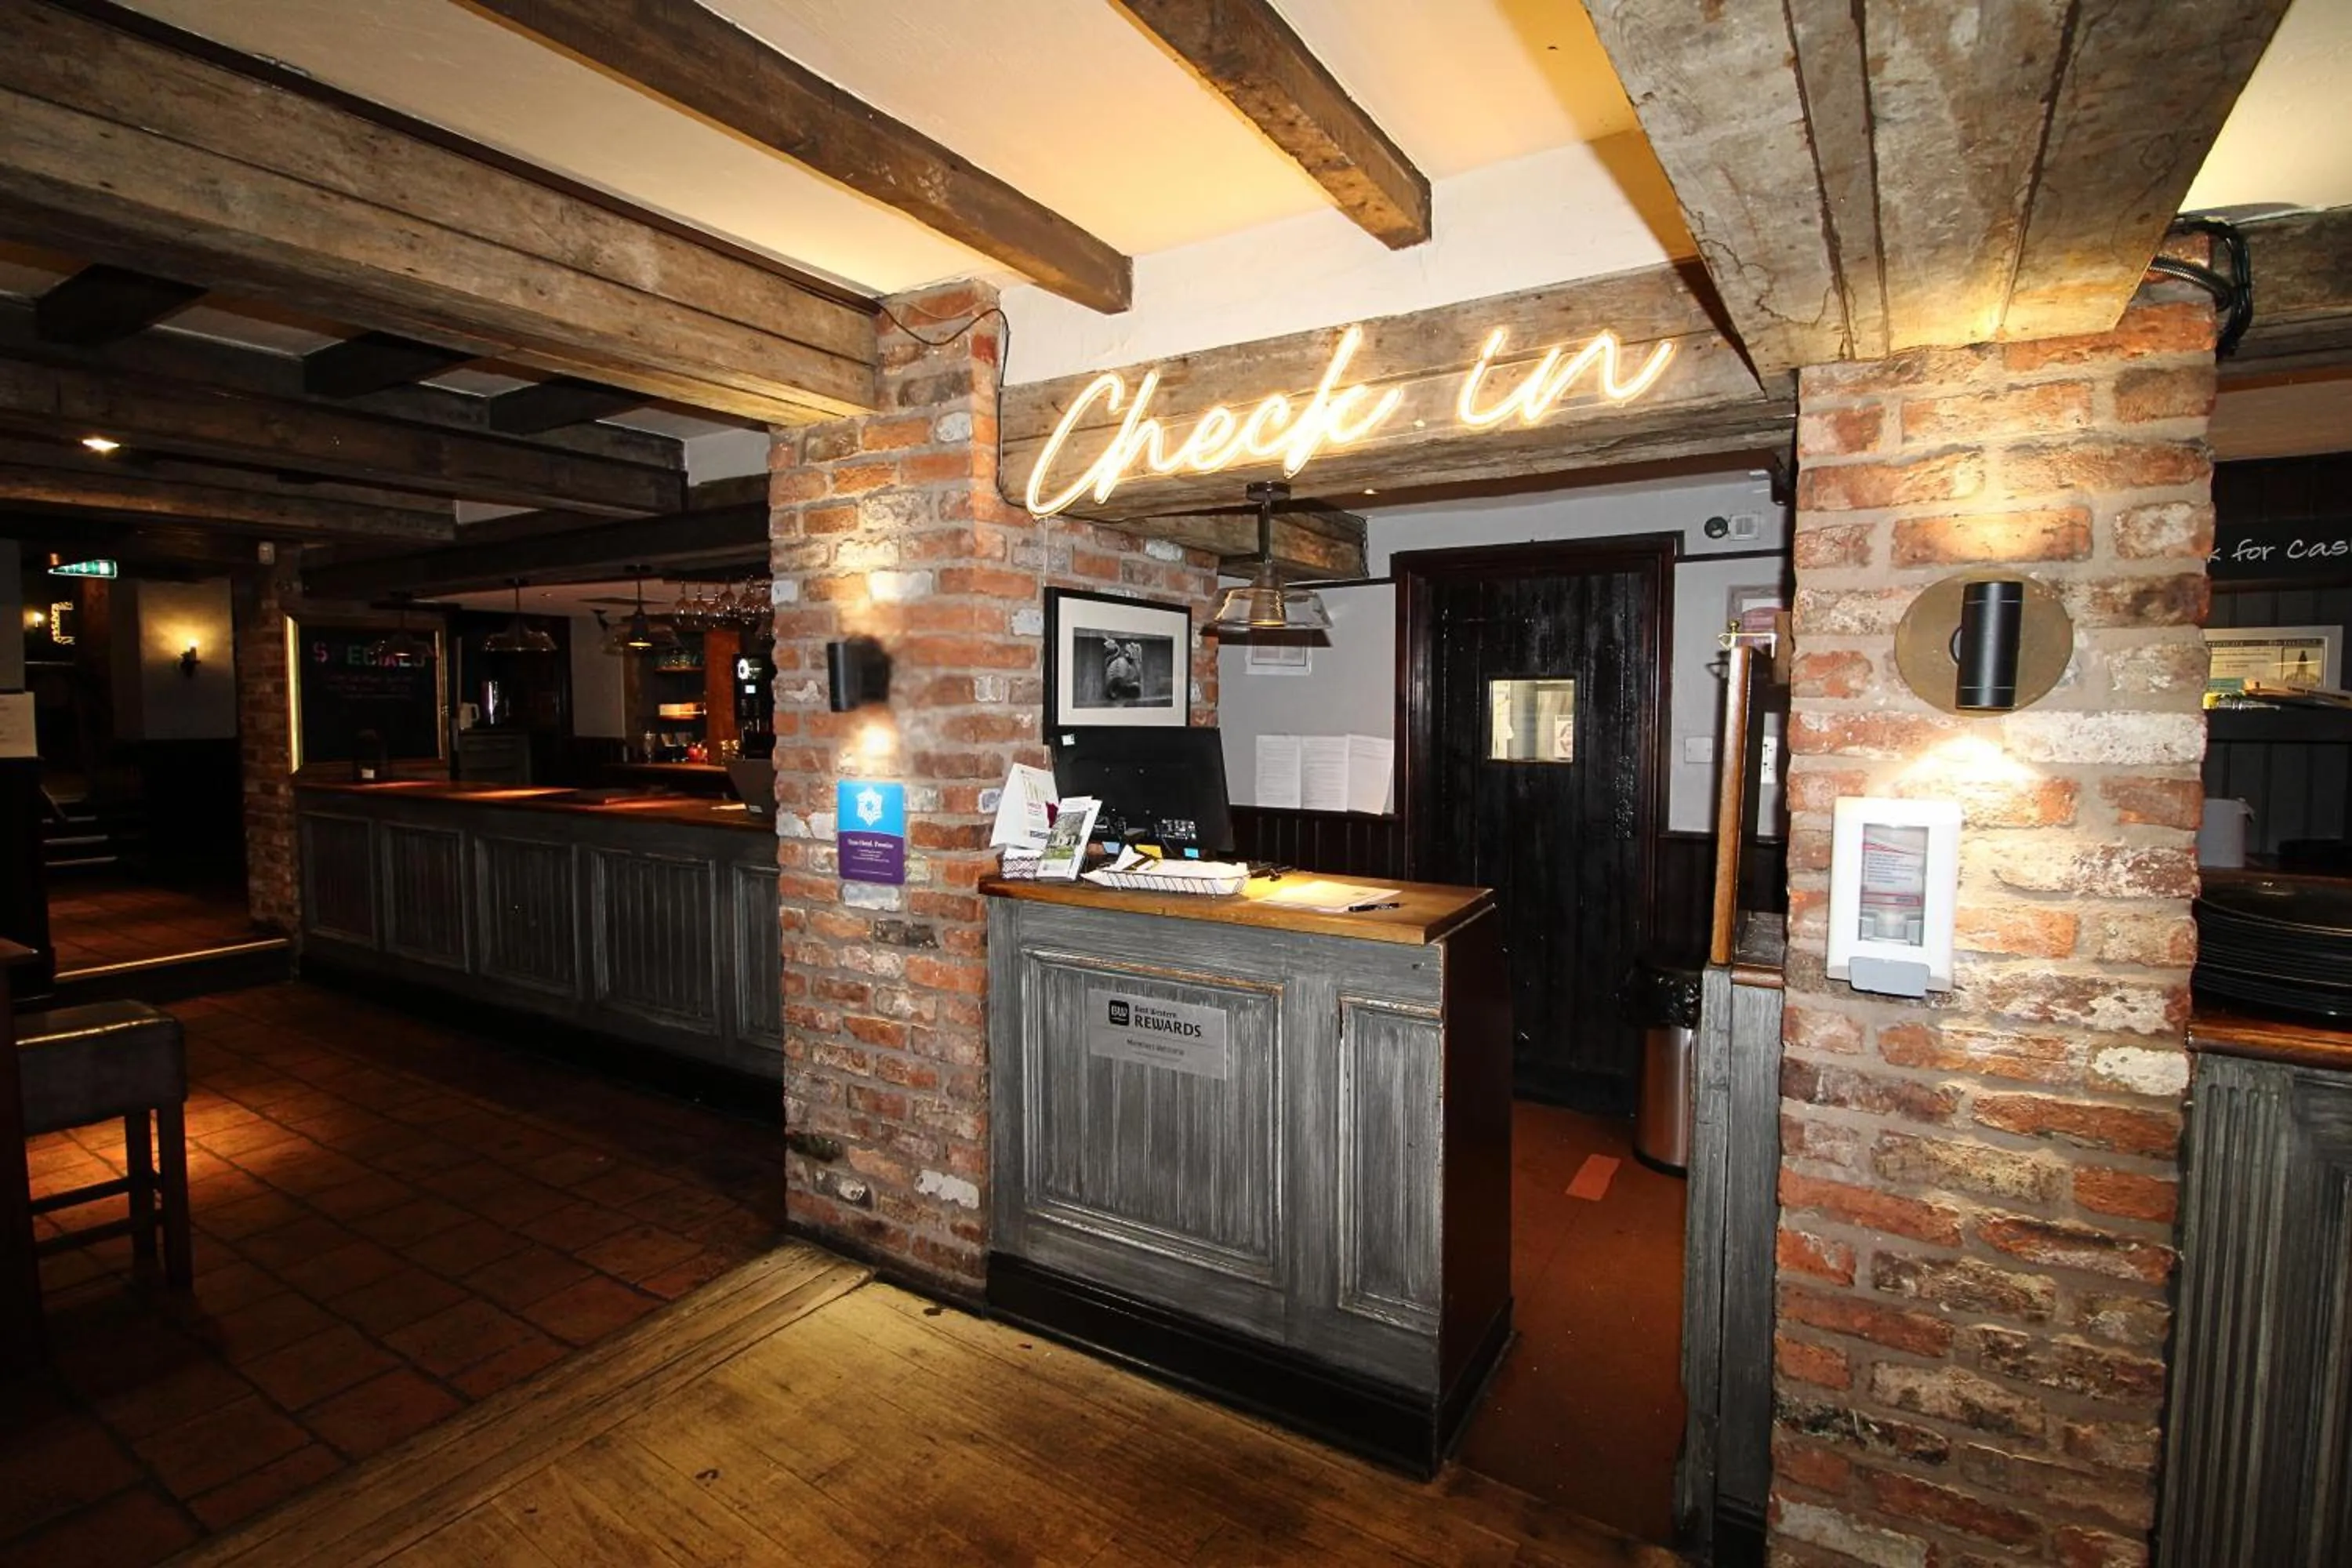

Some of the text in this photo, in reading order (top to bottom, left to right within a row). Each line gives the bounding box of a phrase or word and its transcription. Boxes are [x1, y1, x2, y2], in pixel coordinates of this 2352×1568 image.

[1025, 323, 1676, 520] Check in
[2231, 538, 2277, 562] for
[2286, 538, 2352, 559] Cas
[1134, 1014, 1202, 1037] REWARDS
